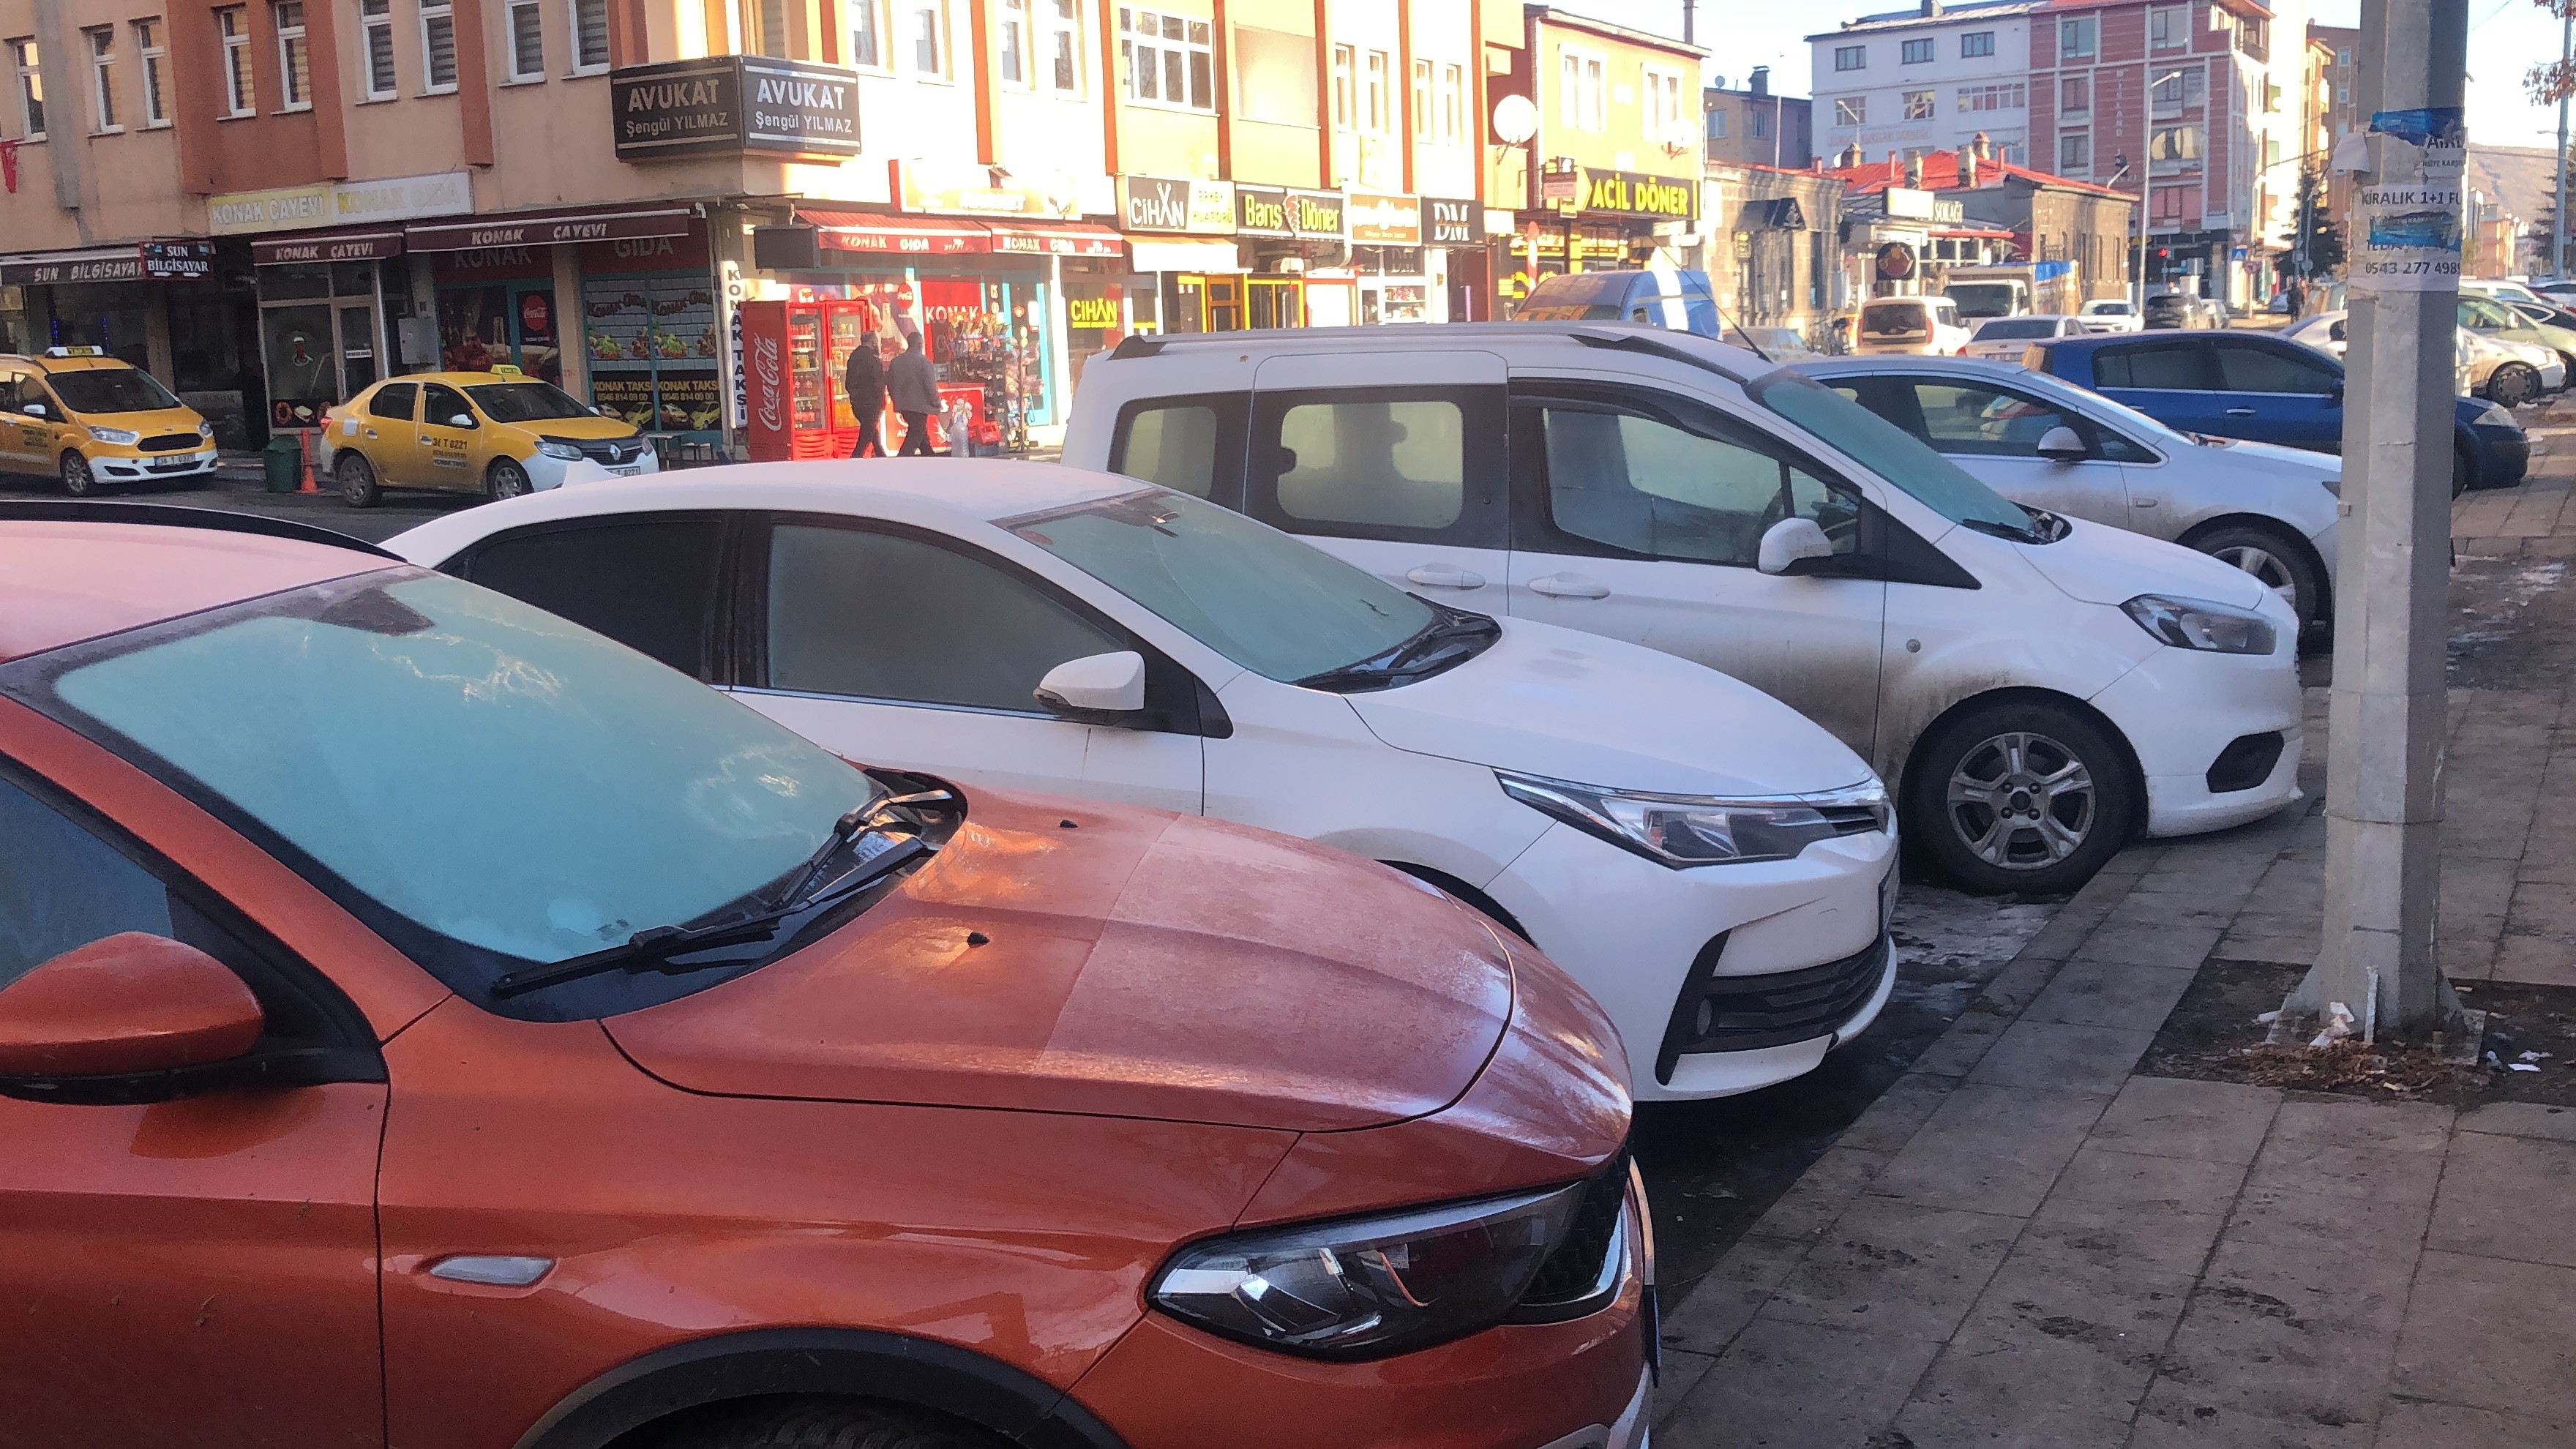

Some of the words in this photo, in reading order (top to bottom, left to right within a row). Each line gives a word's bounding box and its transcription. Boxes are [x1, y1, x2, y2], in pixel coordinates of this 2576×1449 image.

[628, 78, 719, 112] AVUKAT
[757, 78, 845, 111] AVUKAT
[626, 119, 670, 138] Şengül
[675, 112, 728, 131] YILMAZ
[755, 111, 799, 130] Şengül
[804, 115, 853, 133] YILMAZ
[1635, 176, 1688, 215] DÖNER
[2362, 190, 2415, 204] KİRALIK
[2419, 191, 2444, 204] 1+1
[211, 201, 264, 225] KONAK
[1300, 198, 1340, 233] Döner
[1433, 203, 1470, 241] DM
[471, 229, 525, 245] KONAK
[842, 236, 887, 249] KONAK
[899, 238, 929, 251] GIDA
[167, 246, 189, 257] SUN
[276, 245, 319, 261] KONAK
[147, 260, 209, 272] BİLGİSAYAR
[2366, 262, 2398, 274] 0543
[2403, 262, 2430, 274] 277
[34, 267, 59, 282] SUN
[692, 380, 719, 391] TAKS
